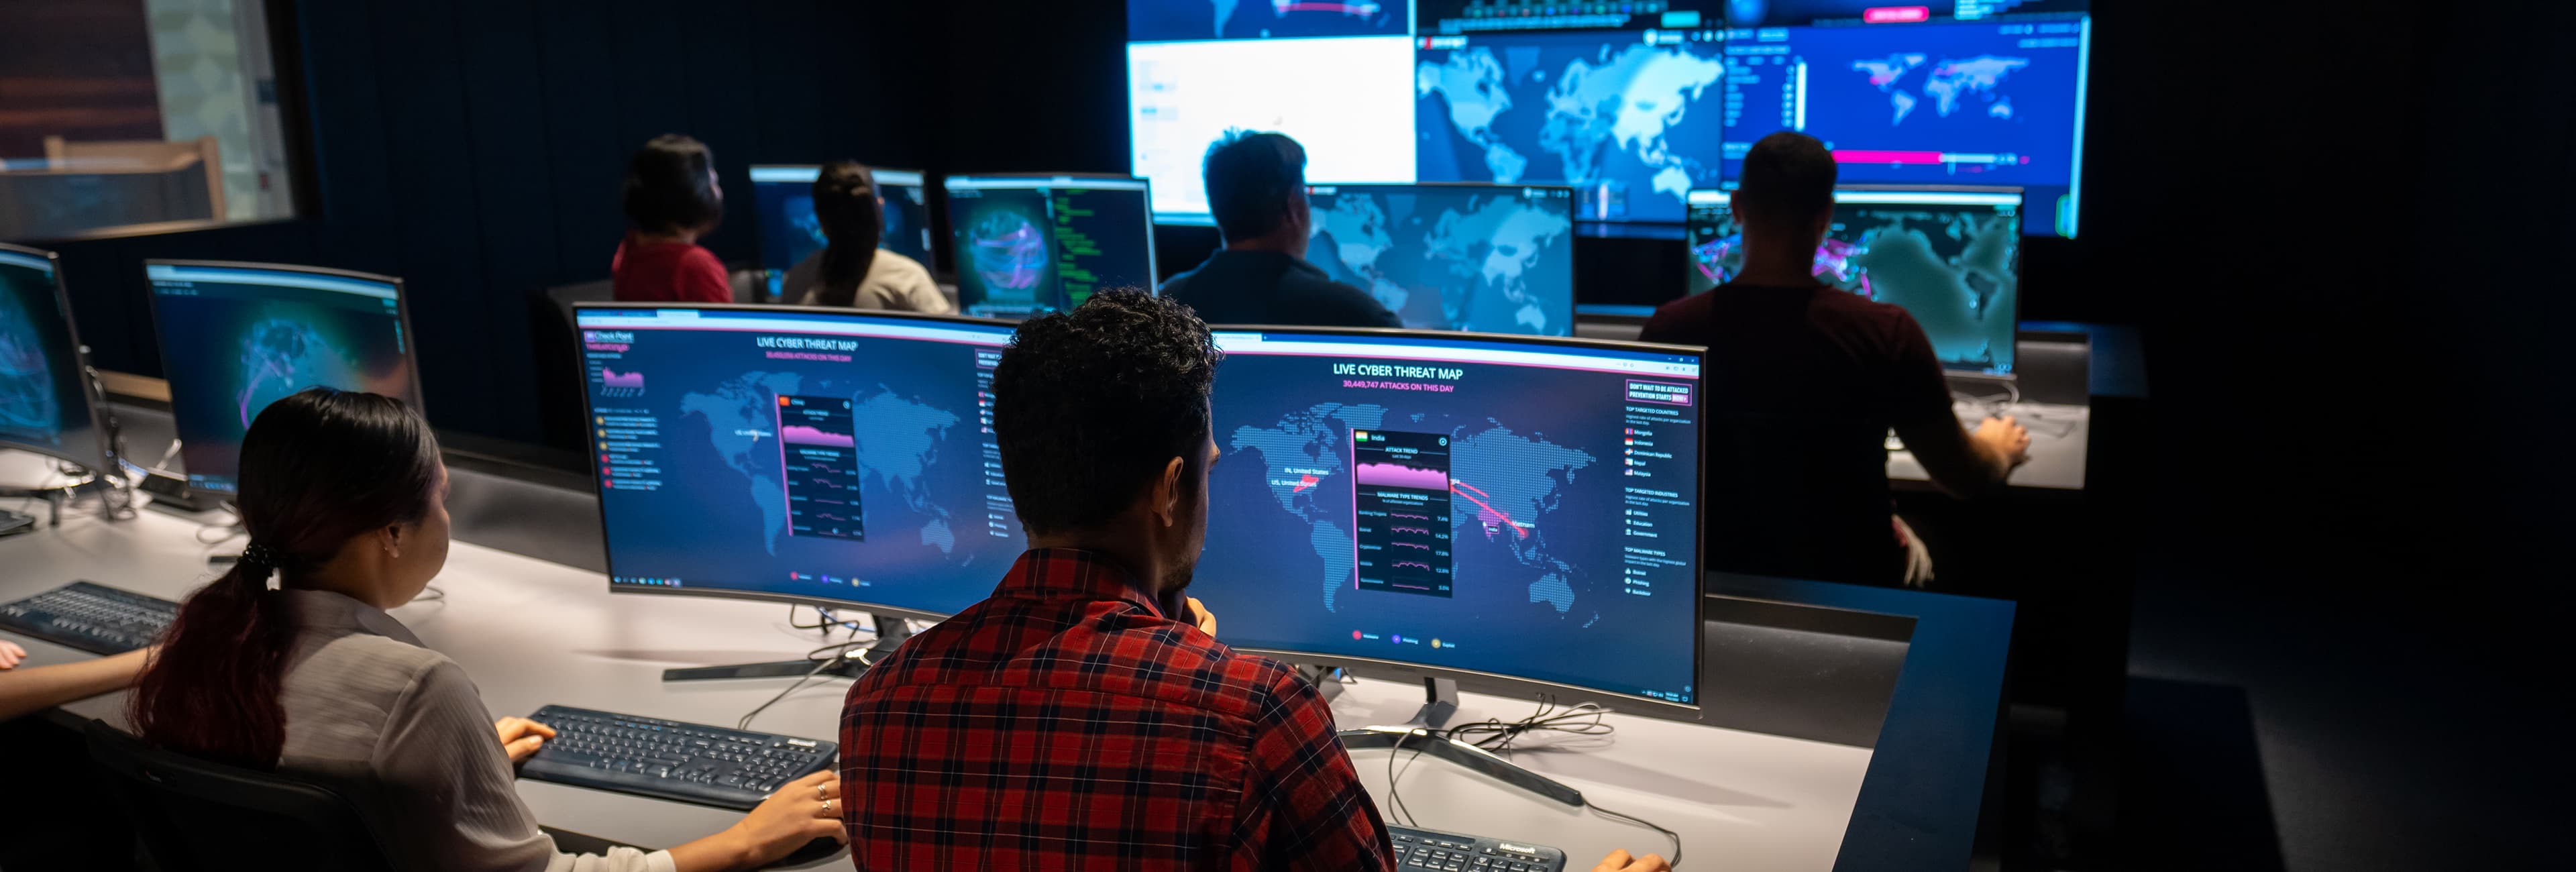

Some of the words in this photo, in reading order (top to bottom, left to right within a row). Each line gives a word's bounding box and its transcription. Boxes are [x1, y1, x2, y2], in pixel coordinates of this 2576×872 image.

[596, 331, 614, 339] Check
[615, 331, 631, 340] Point
[757, 337, 775, 347] LIVE
[776, 337, 804, 349] CYBER
[805, 339, 837, 350] THREAT
[839, 341, 858, 351] MAP
[1334, 364, 1356, 374] LIVE
[1358, 364, 1393, 376] CYBER
[1394, 366, 1436, 379] THREAT
[1438, 368, 1463, 380] MAP
[1343, 380, 1378, 388] 30,449,747
[1380, 381, 1409, 390] ATTACKS
[1411, 383, 1421, 391] ON
[1423, 384, 1438, 392] THIS
[1512, 520, 1535, 529] Vietnam
[1499, 843, 1536, 854] Microsoft
